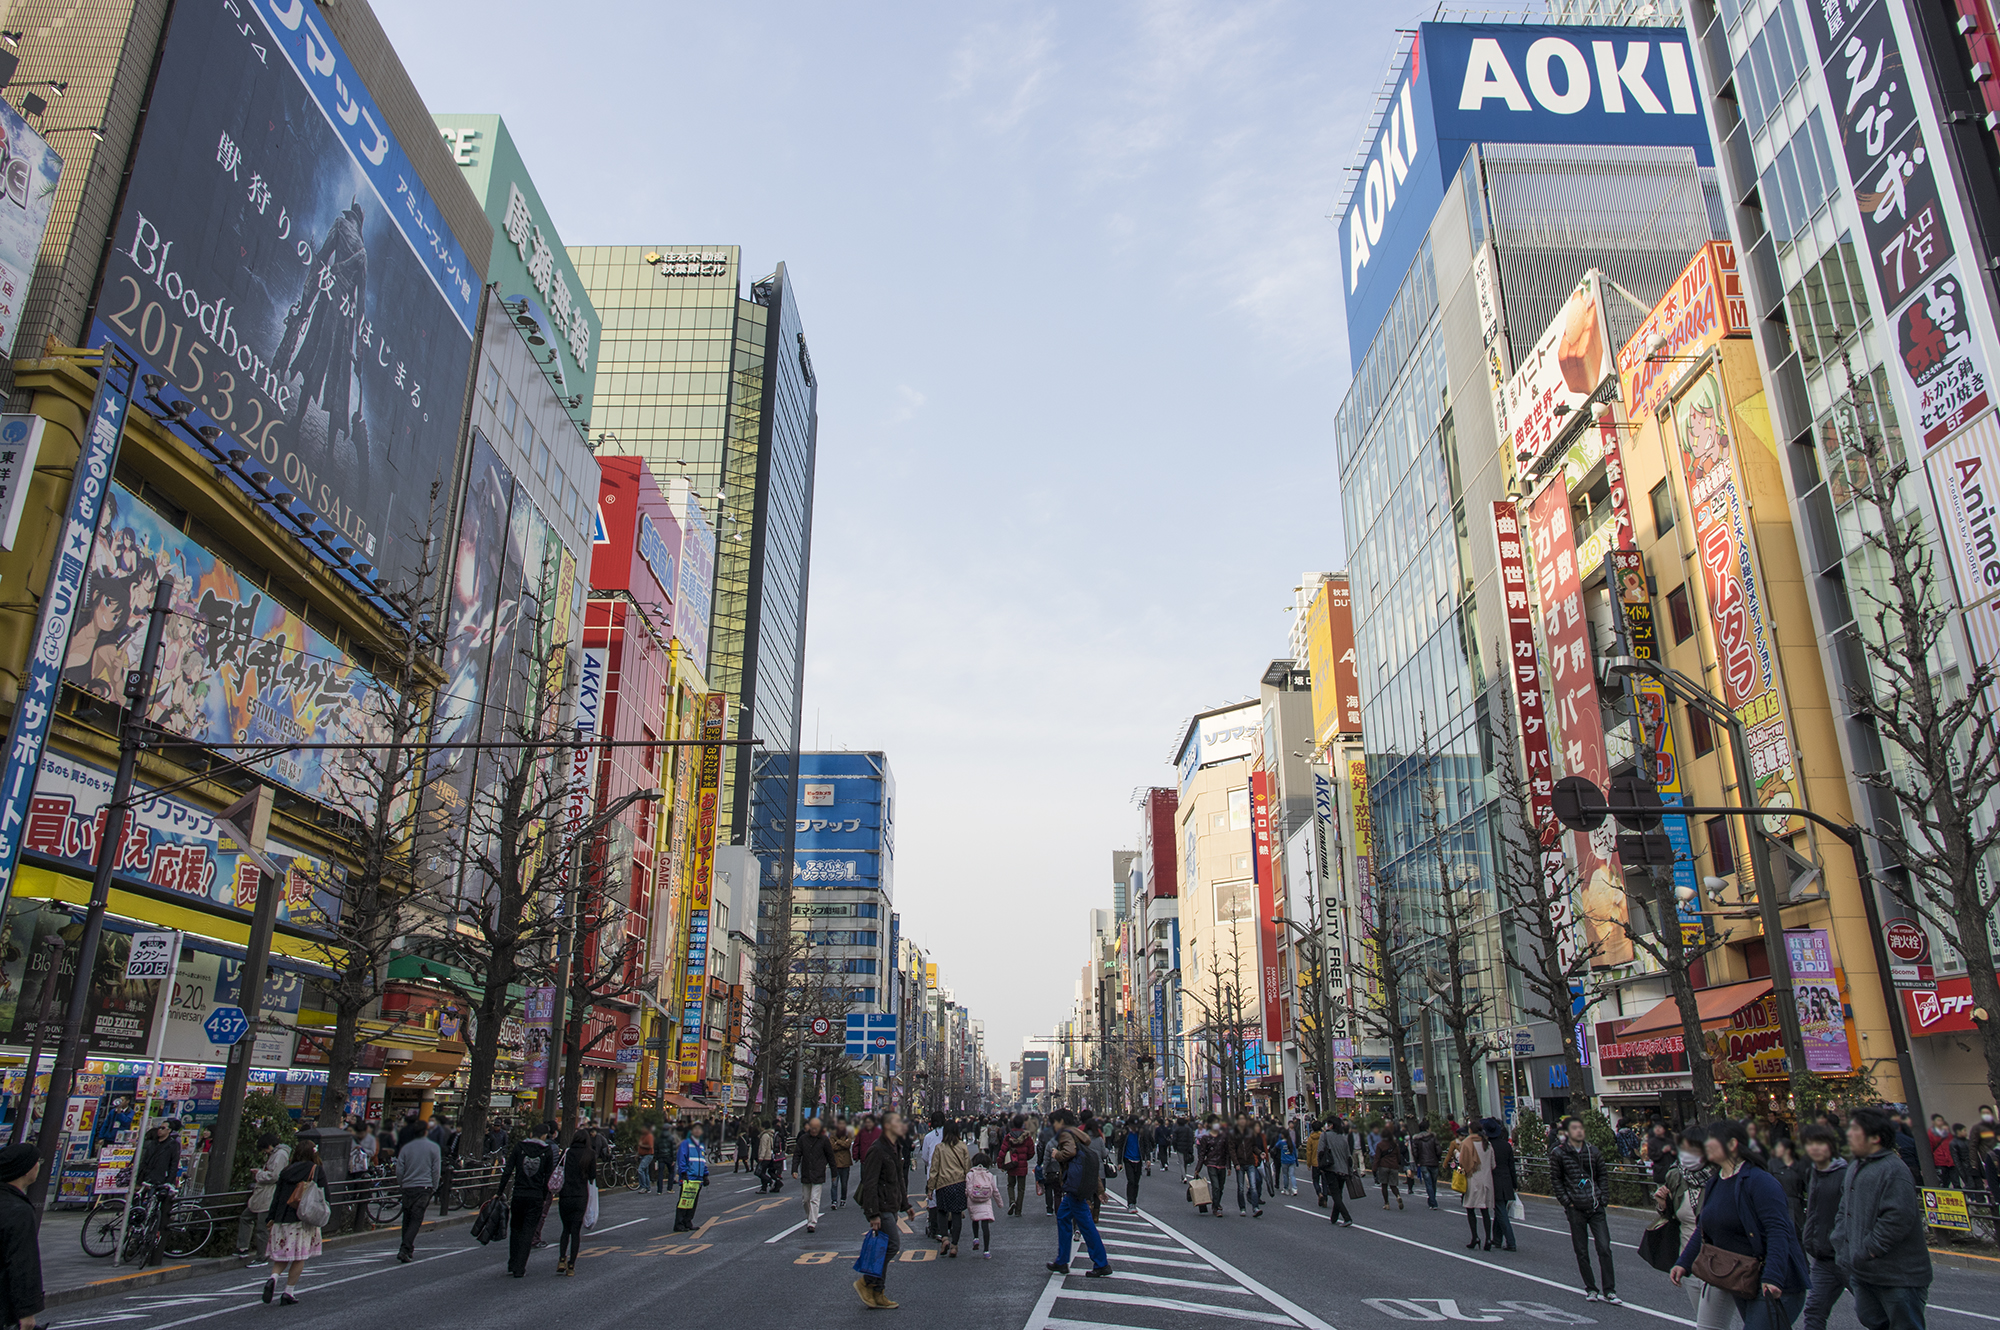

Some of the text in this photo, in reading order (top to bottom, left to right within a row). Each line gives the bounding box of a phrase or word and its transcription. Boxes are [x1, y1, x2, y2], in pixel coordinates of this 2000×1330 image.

[1458, 37, 1698, 115] AOKI
[1351, 78, 1418, 296] AOKI
[396, 174, 471, 304] アミューズメント館
[1906, 207, 1935, 248] 入口
[661, 264, 725, 277] 秋葉原ビル
[662, 252, 727, 264] 住友不動産
[1682, 253, 1708, 309] DVD
[116, 211, 292, 415] Bloodborne
[1486, 324, 1497, 346] 8F
[1517, 335, 1557, 392] ハニトー
[1920, 356, 1975, 412] 赤から鍋
[109, 275, 367, 548] 2015.3.26 ON SALE
[1919, 372, 1985, 430] セセリ焼き
[1946, 409, 1965, 433] 5F
[79, 414, 118, 520] 売るのも
[1948, 476, 1982, 584] Produced by ADORES
[640, 513, 675, 600] SEGA
[43, 550, 85, 662] 買うのも
[1497, 516, 1531, 625] 曲数世界一
[1515, 640, 1543, 734] カラオケ
[1704, 522, 1757, 698] ラムタラ
[580, 652, 602, 719] AKKY
[280, 714, 306, 743] VERSUS
[71, 769, 101, 790] 買うのも
[1315, 773, 1332, 880] AKKY INTERNATIONAL
[657, 857, 671, 891] GAME
[802, 869, 846, 881] ソフマップ
[1324, 896, 1339, 941] DUTY
[134, 950, 168, 961] タクシー
[1789, 938, 1825, 949] 秋葉原
[1890, 934, 1920, 949] 消火栓
[129, 962, 167, 975] のりば
[1329, 947, 1343, 988] FREE
[1794, 960, 1830, 972] まつり
[1891, 967, 1916, 976] docomo
[207, 1018, 243, 1033] 437
[816, 1021, 826, 1030] 50
[1333, 995, 1346, 1038] SOP
[1732, 1000, 1769, 1031] DVD
[1753, 1058, 1783, 1075] ラムタラ
[792, 1249, 938, 1266] 8-0
